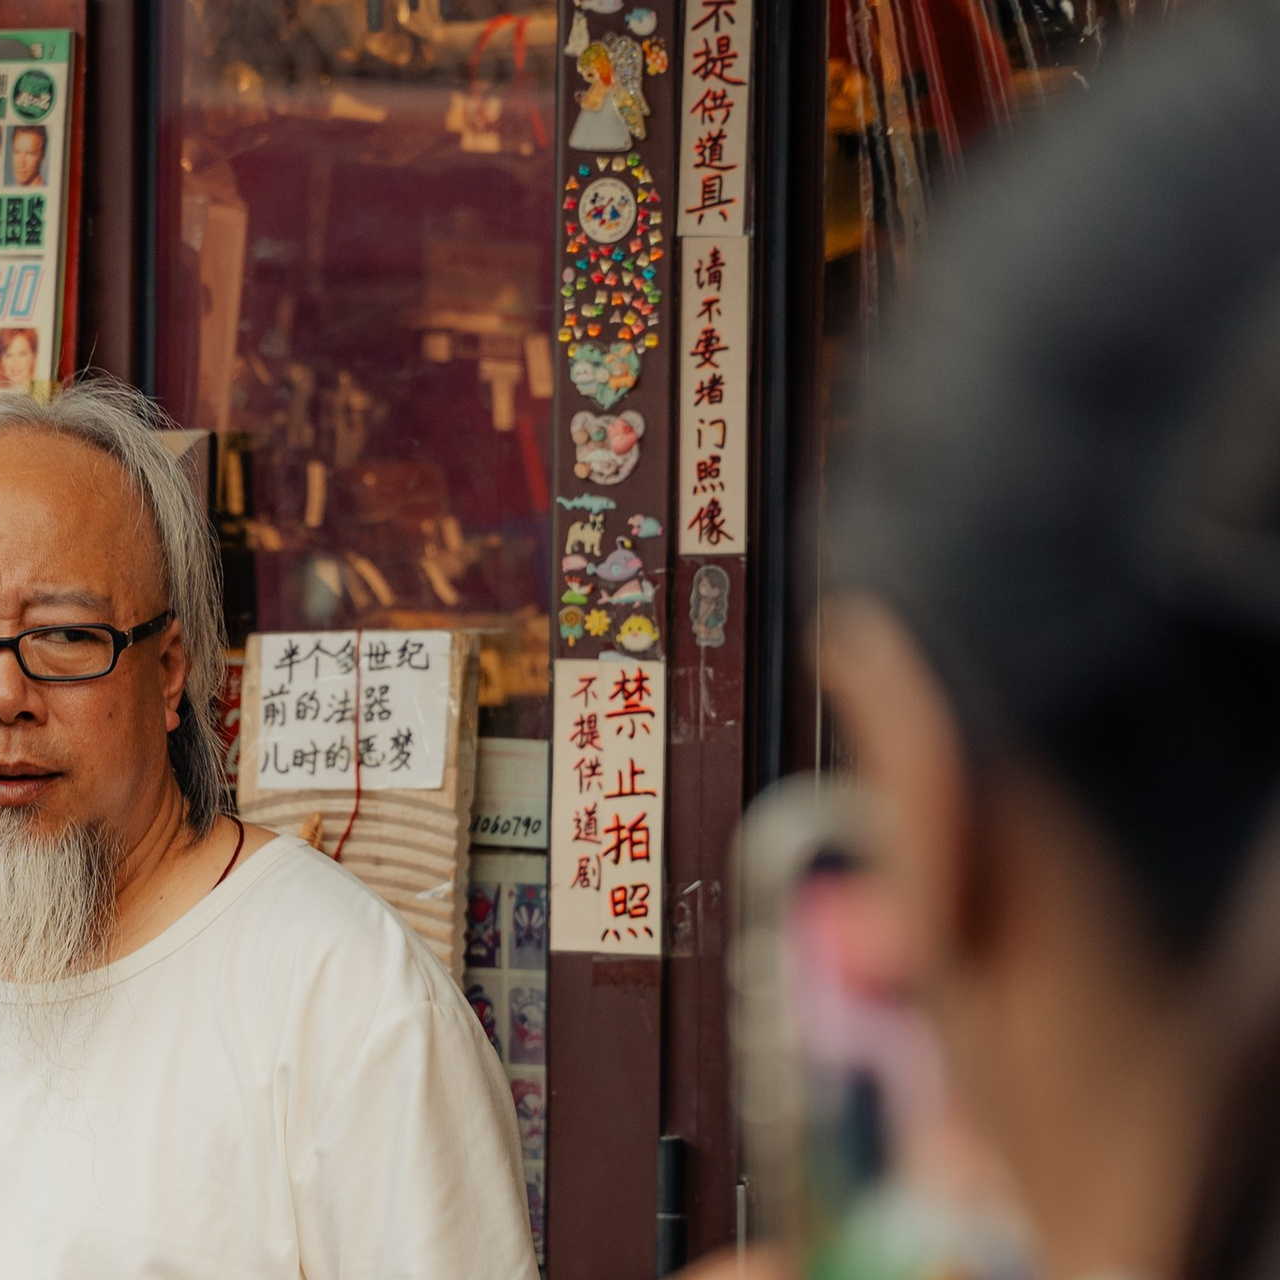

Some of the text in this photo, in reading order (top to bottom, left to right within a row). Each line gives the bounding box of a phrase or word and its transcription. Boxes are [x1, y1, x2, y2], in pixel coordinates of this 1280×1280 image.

[687, 244, 734, 546] 请不要堵门照像
[274, 637, 431, 684] 半个多世纪
[261, 684, 393, 728] 前的法器
[260, 726, 416, 776] 儿时的恶梦
[600, 665, 657, 943] 禁止拍照
